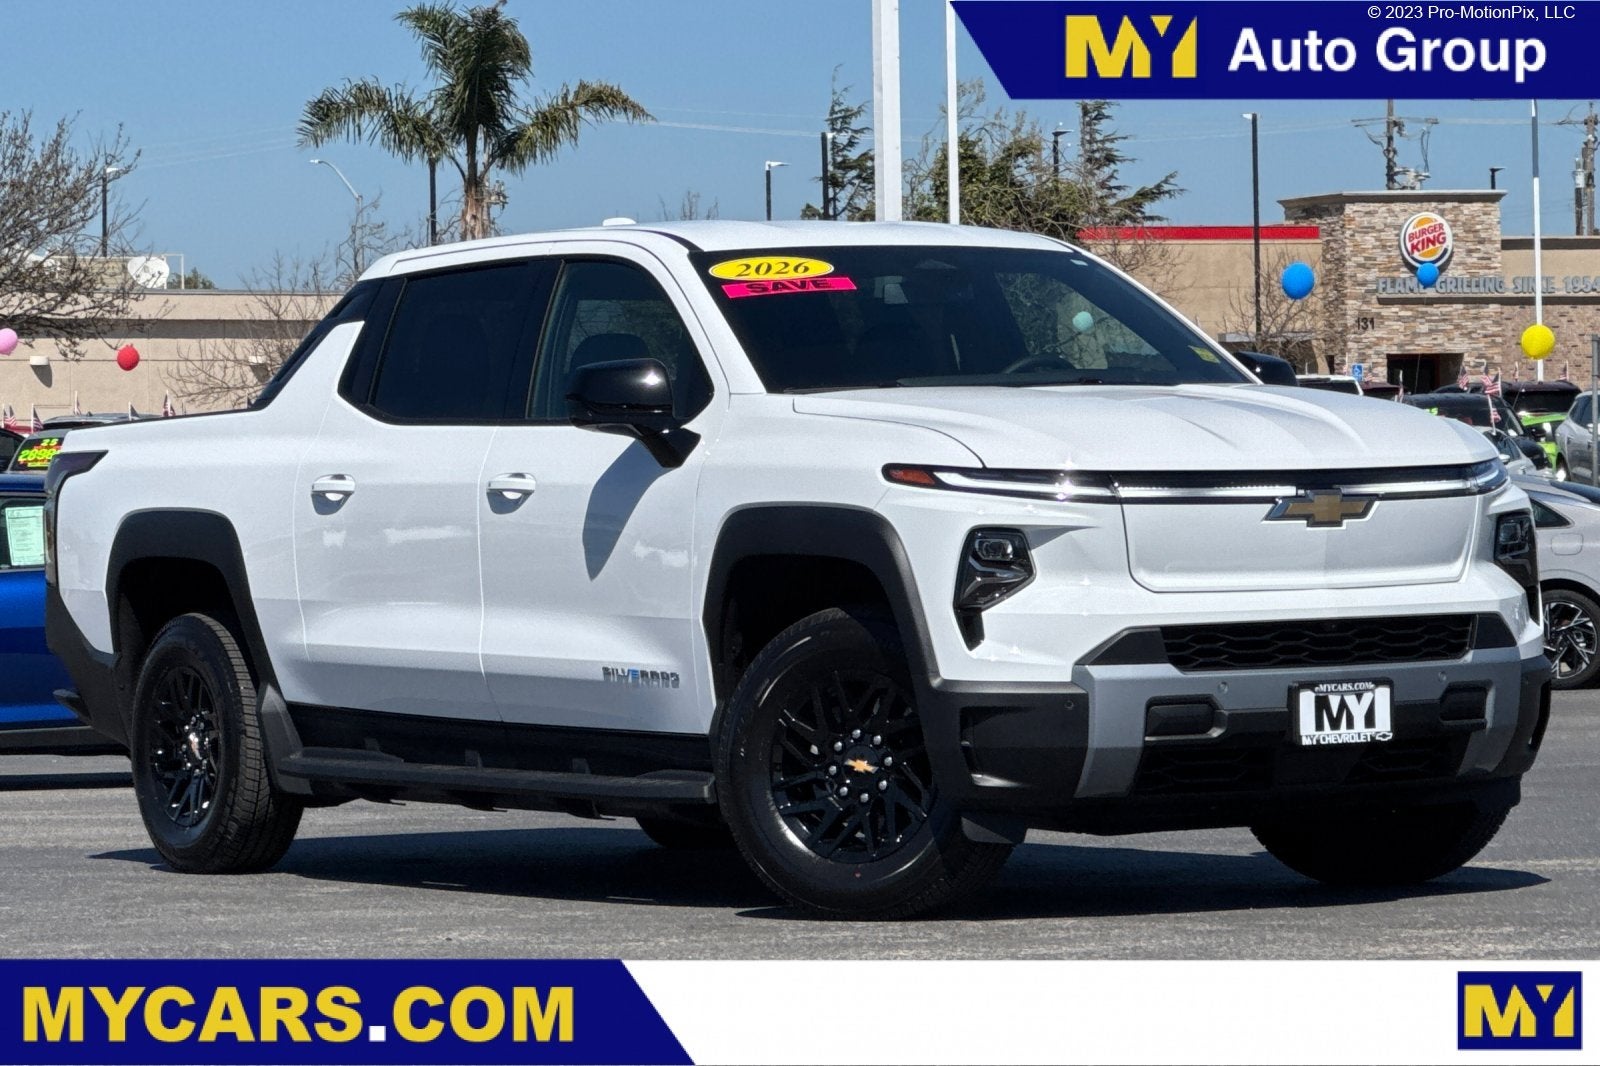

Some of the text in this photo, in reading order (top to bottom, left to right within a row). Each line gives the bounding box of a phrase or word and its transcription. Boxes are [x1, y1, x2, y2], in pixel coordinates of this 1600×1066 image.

[1408, 223, 1444, 243] BURGER
[1410, 232, 1447, 255] KING
[735, 261, 810, 277] 2026
[745, 279, 834, 295] SAVE
[1435, 276, 1505, 294] GRILLING
[1563, 276, 1600, 293] 1954
[1355, 317, 1375, 330] 131
[1315, 692, 1376, 731] MY
[1302, 732, 1371, 745] MY CHEVROLET
